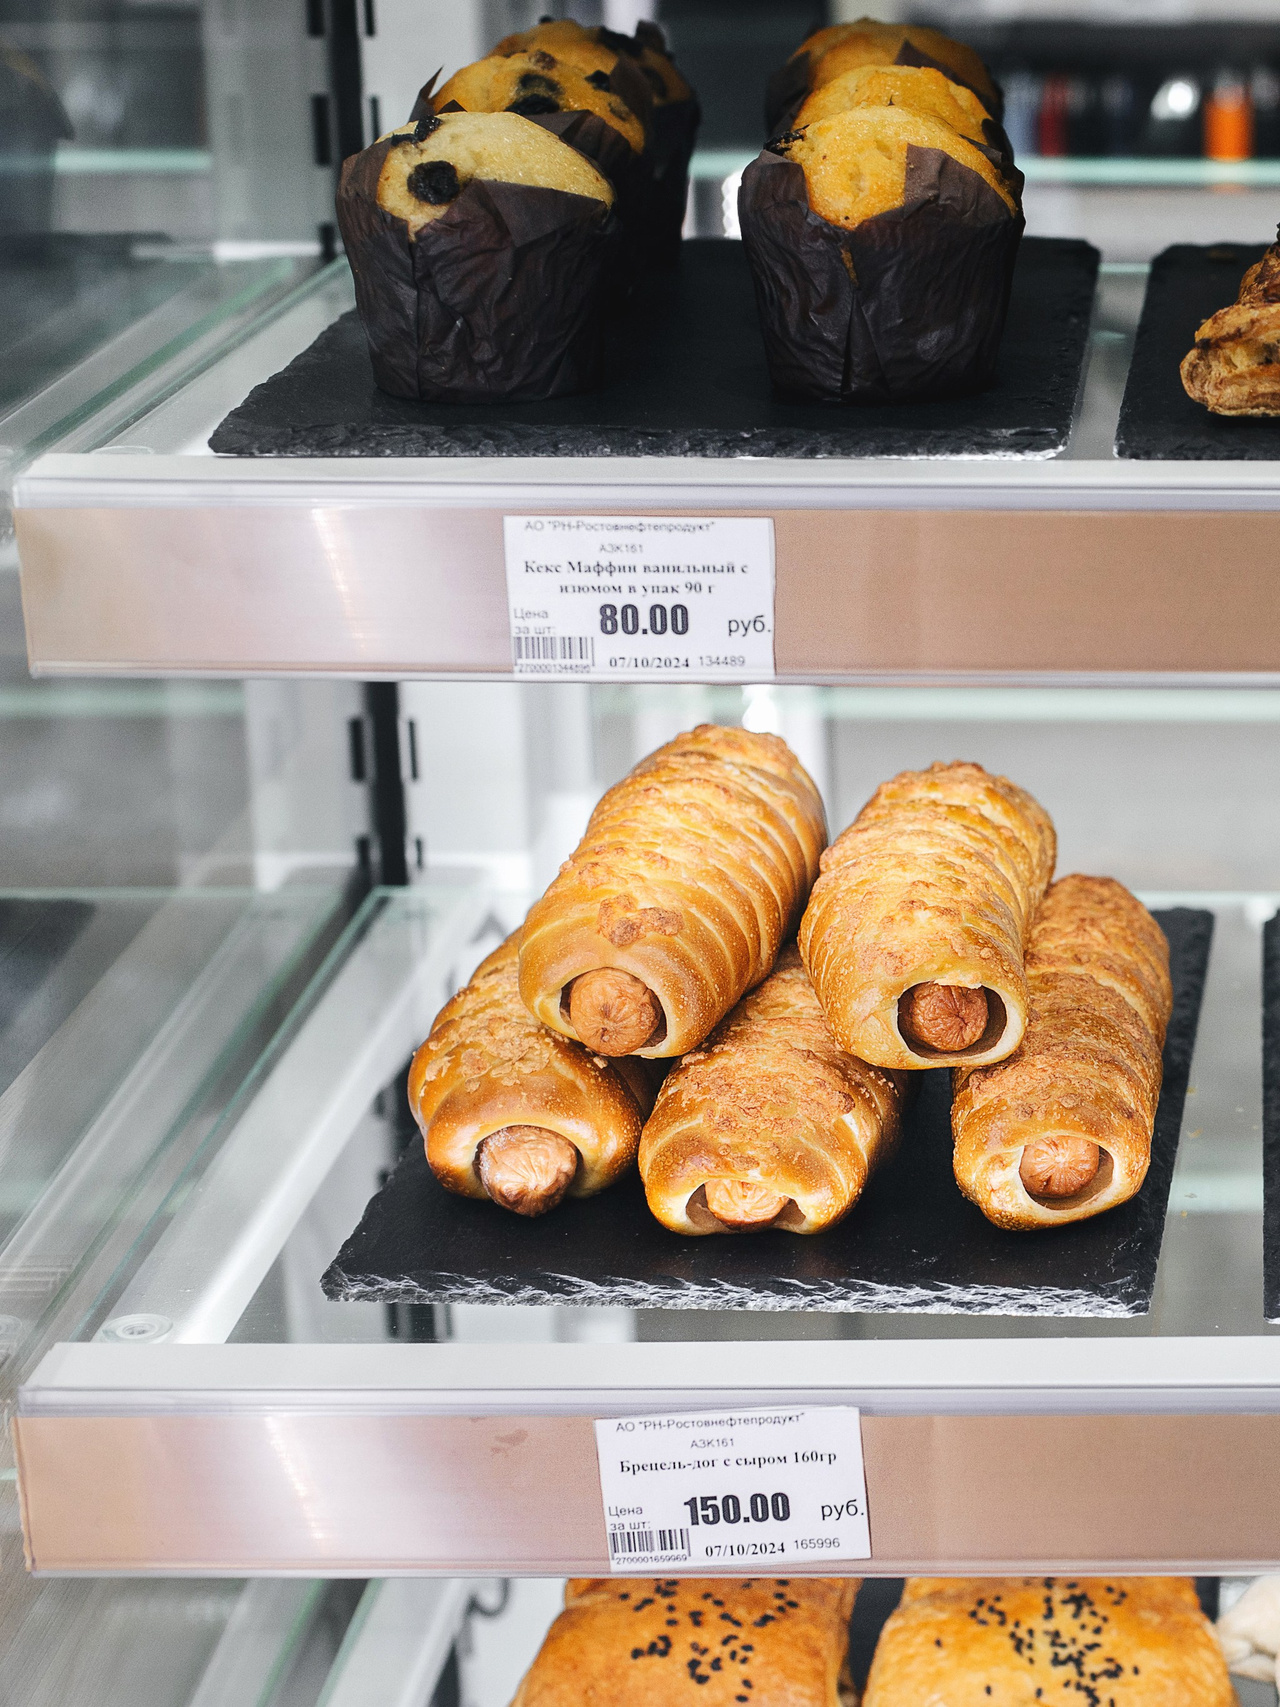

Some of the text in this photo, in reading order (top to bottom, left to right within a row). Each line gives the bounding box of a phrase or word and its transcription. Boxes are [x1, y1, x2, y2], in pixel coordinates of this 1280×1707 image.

[524, 521, 545, 532] АО
[525, 560, 748, 576] Кекс Маффин ванильный с
[560, 581, 716, 597] изюмом в упак 90 г
[514, 609, 548, 620] Цена
[599, 603, 772, 637] 80.00 руб.
[514, 625, 531, 635] за
[609, 656, 746, 668] 07/10/2024 134489
[616, 1412, 805, 1432] АО "РН-Ростовнефтепродукт"
[690, 1438, 735, 1449] АЗК161
[620, 1450, 837, 1475] Брецель-дог с сыром 160гр
[608, 1505, 643, 1517] Цена
[684, 1491, 865, 1526] 150.00 руб.
[610, 1520, 651, 1531] за шт:
[705, 1537, 840, 1558] 07/10/2024 165996
